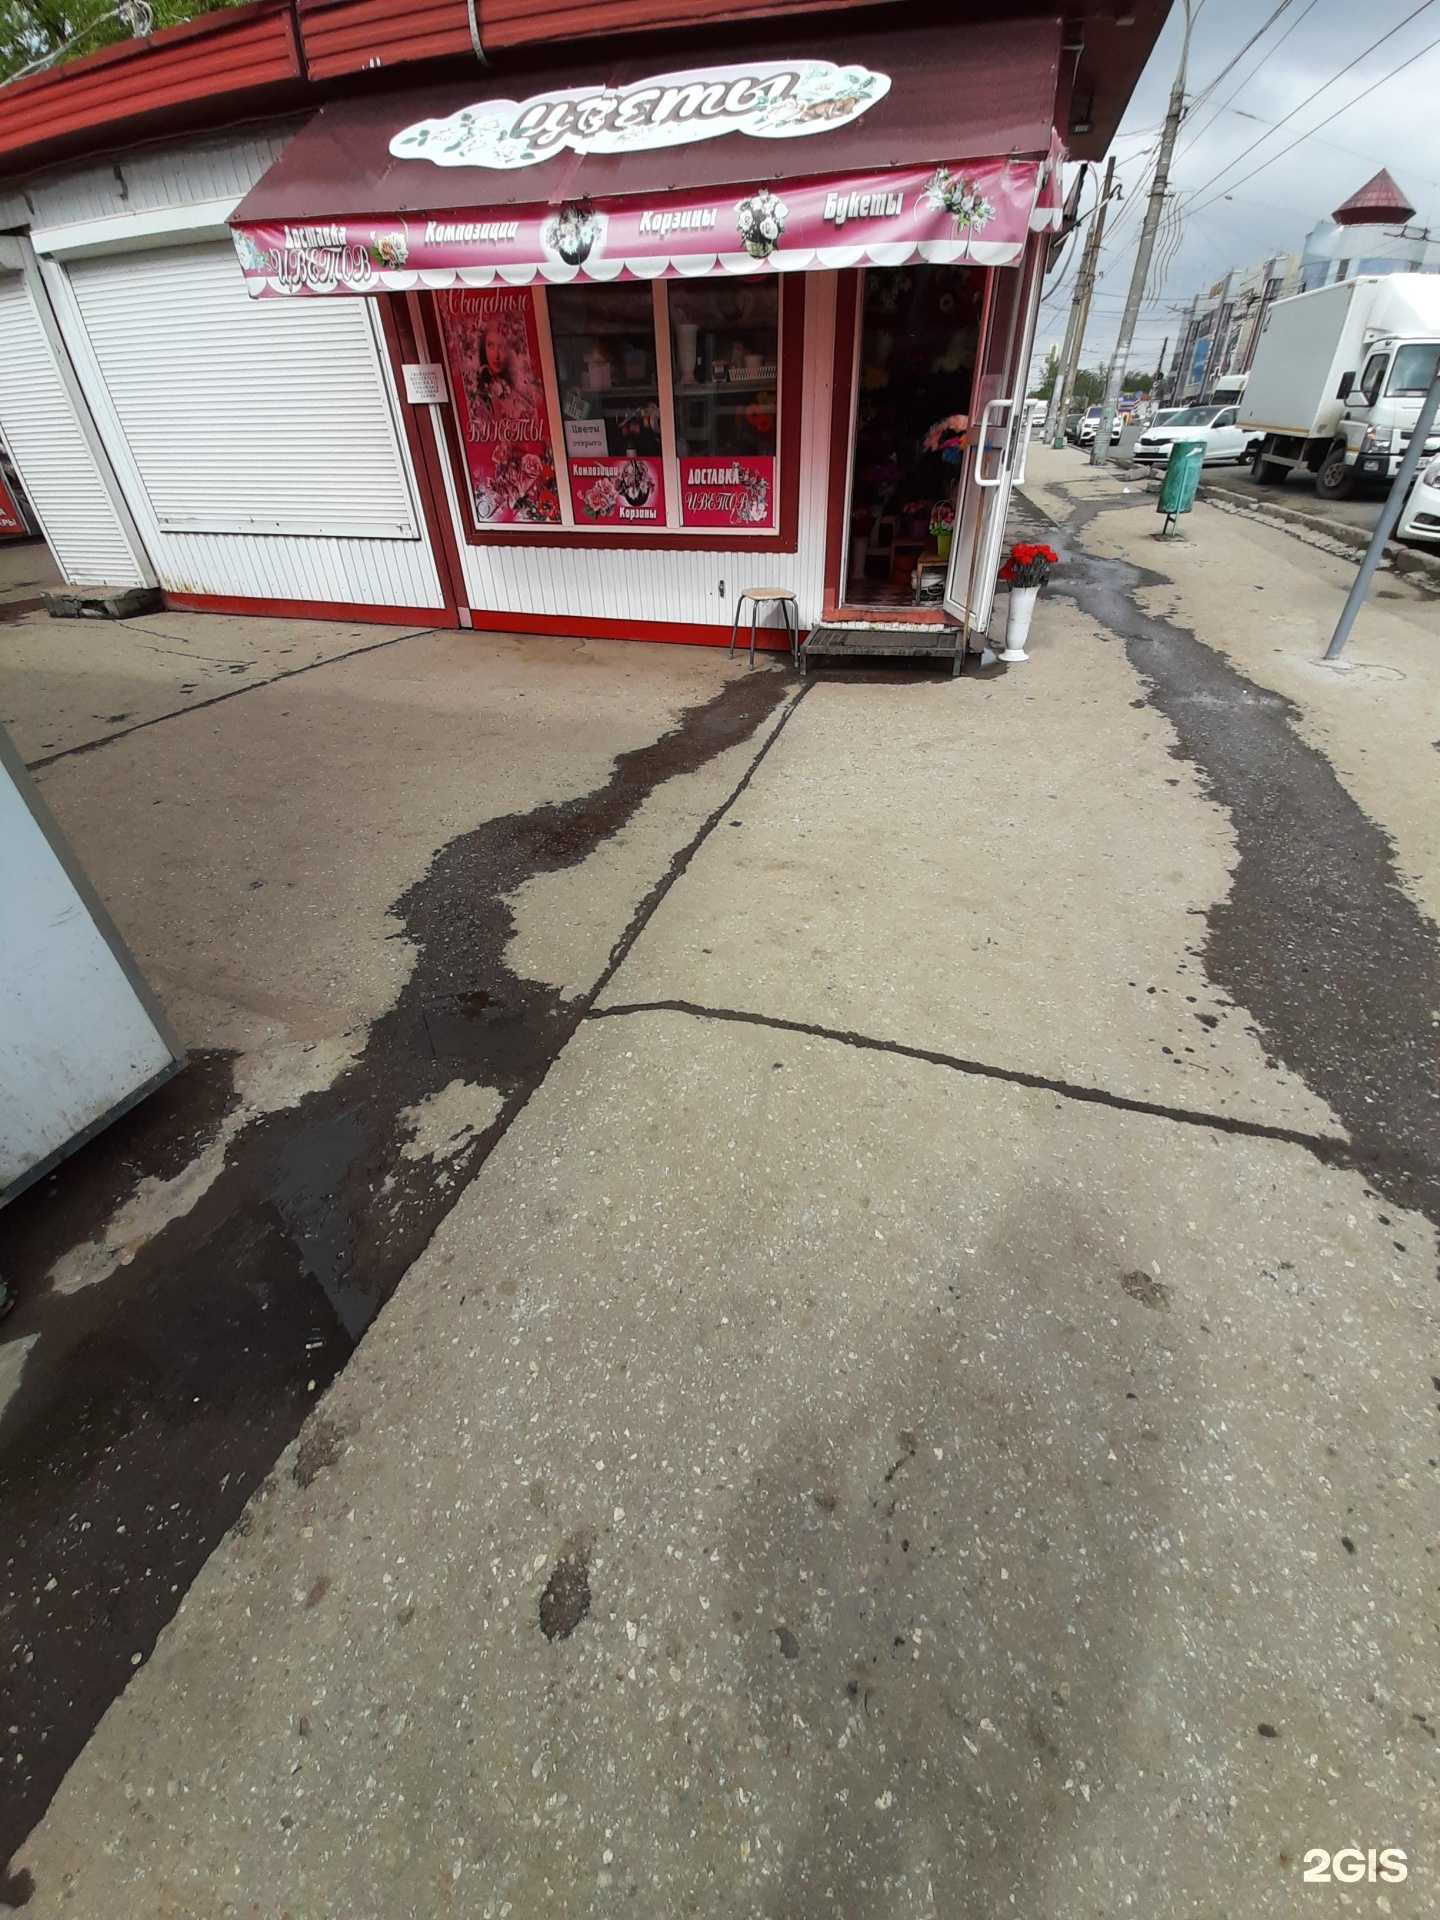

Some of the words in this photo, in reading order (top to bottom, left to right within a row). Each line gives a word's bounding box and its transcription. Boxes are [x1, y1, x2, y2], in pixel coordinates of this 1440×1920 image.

[824, 191, 904, 225] Букеты
[425, 221, 519, 243] Композиции
[640, 208, 718, 235] Корзины
[620, 507, 656, 519] Корзины
